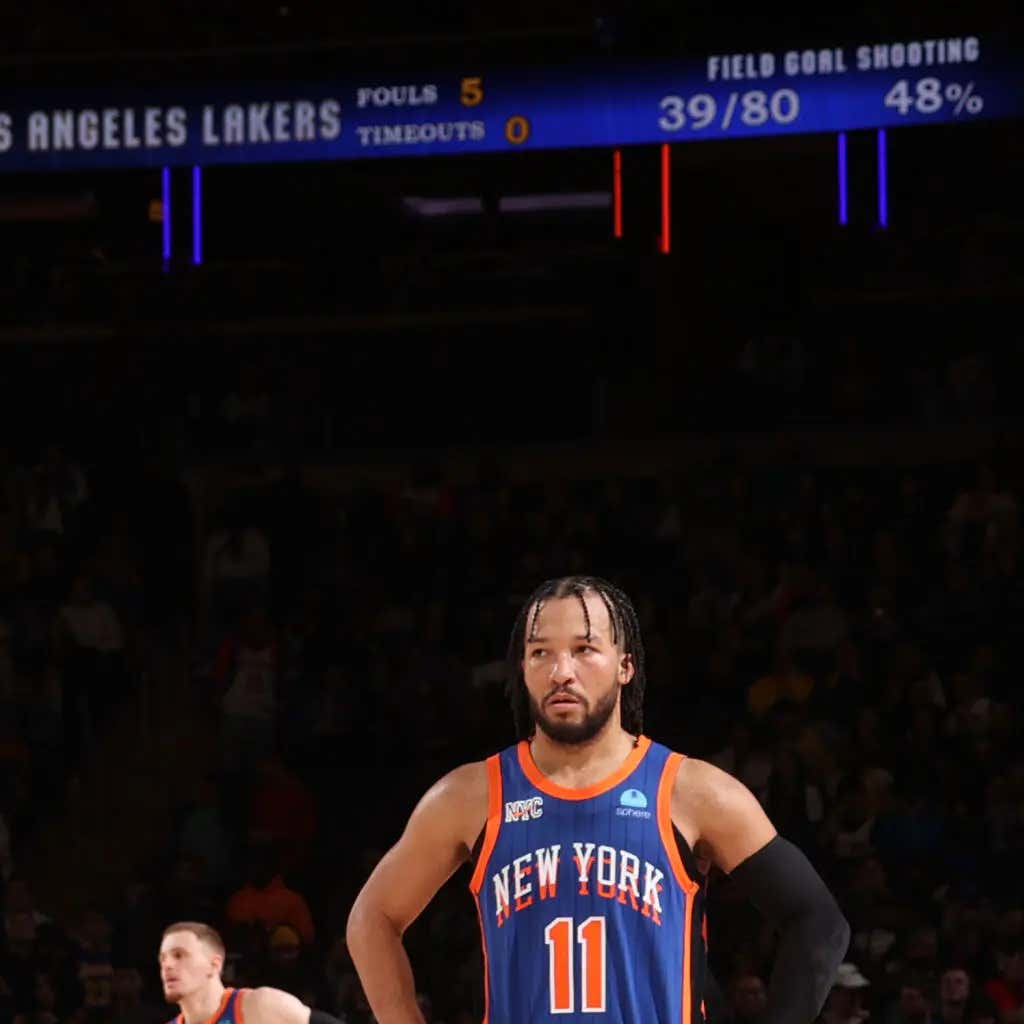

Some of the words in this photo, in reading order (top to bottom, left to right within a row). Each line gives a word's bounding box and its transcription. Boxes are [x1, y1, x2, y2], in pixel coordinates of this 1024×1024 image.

[707, 53, 776, 81] FIELD
[784, 48, 846, 76] GOAL
[856, 36, 980, 71] SHOOTING
[357, 84, 438, 107] FOULS
[462, 78, 483, 105] 5
[658, 88, 800, 131] 39/80
[884, 77, 983, 115] 48%
[27, 108, 188, 151] ANGELES
[202, 100, 341, 146] LAKERS
[358, 121, 486, 145] TIMEOUTS
[505, 116, 529, 144] 0
[504, 796, 544, 823] NYC
[492, 844, 561, 928] NEW
[573, 842, 665, 927] YORK
[544, 916, 606, 1014] 11
